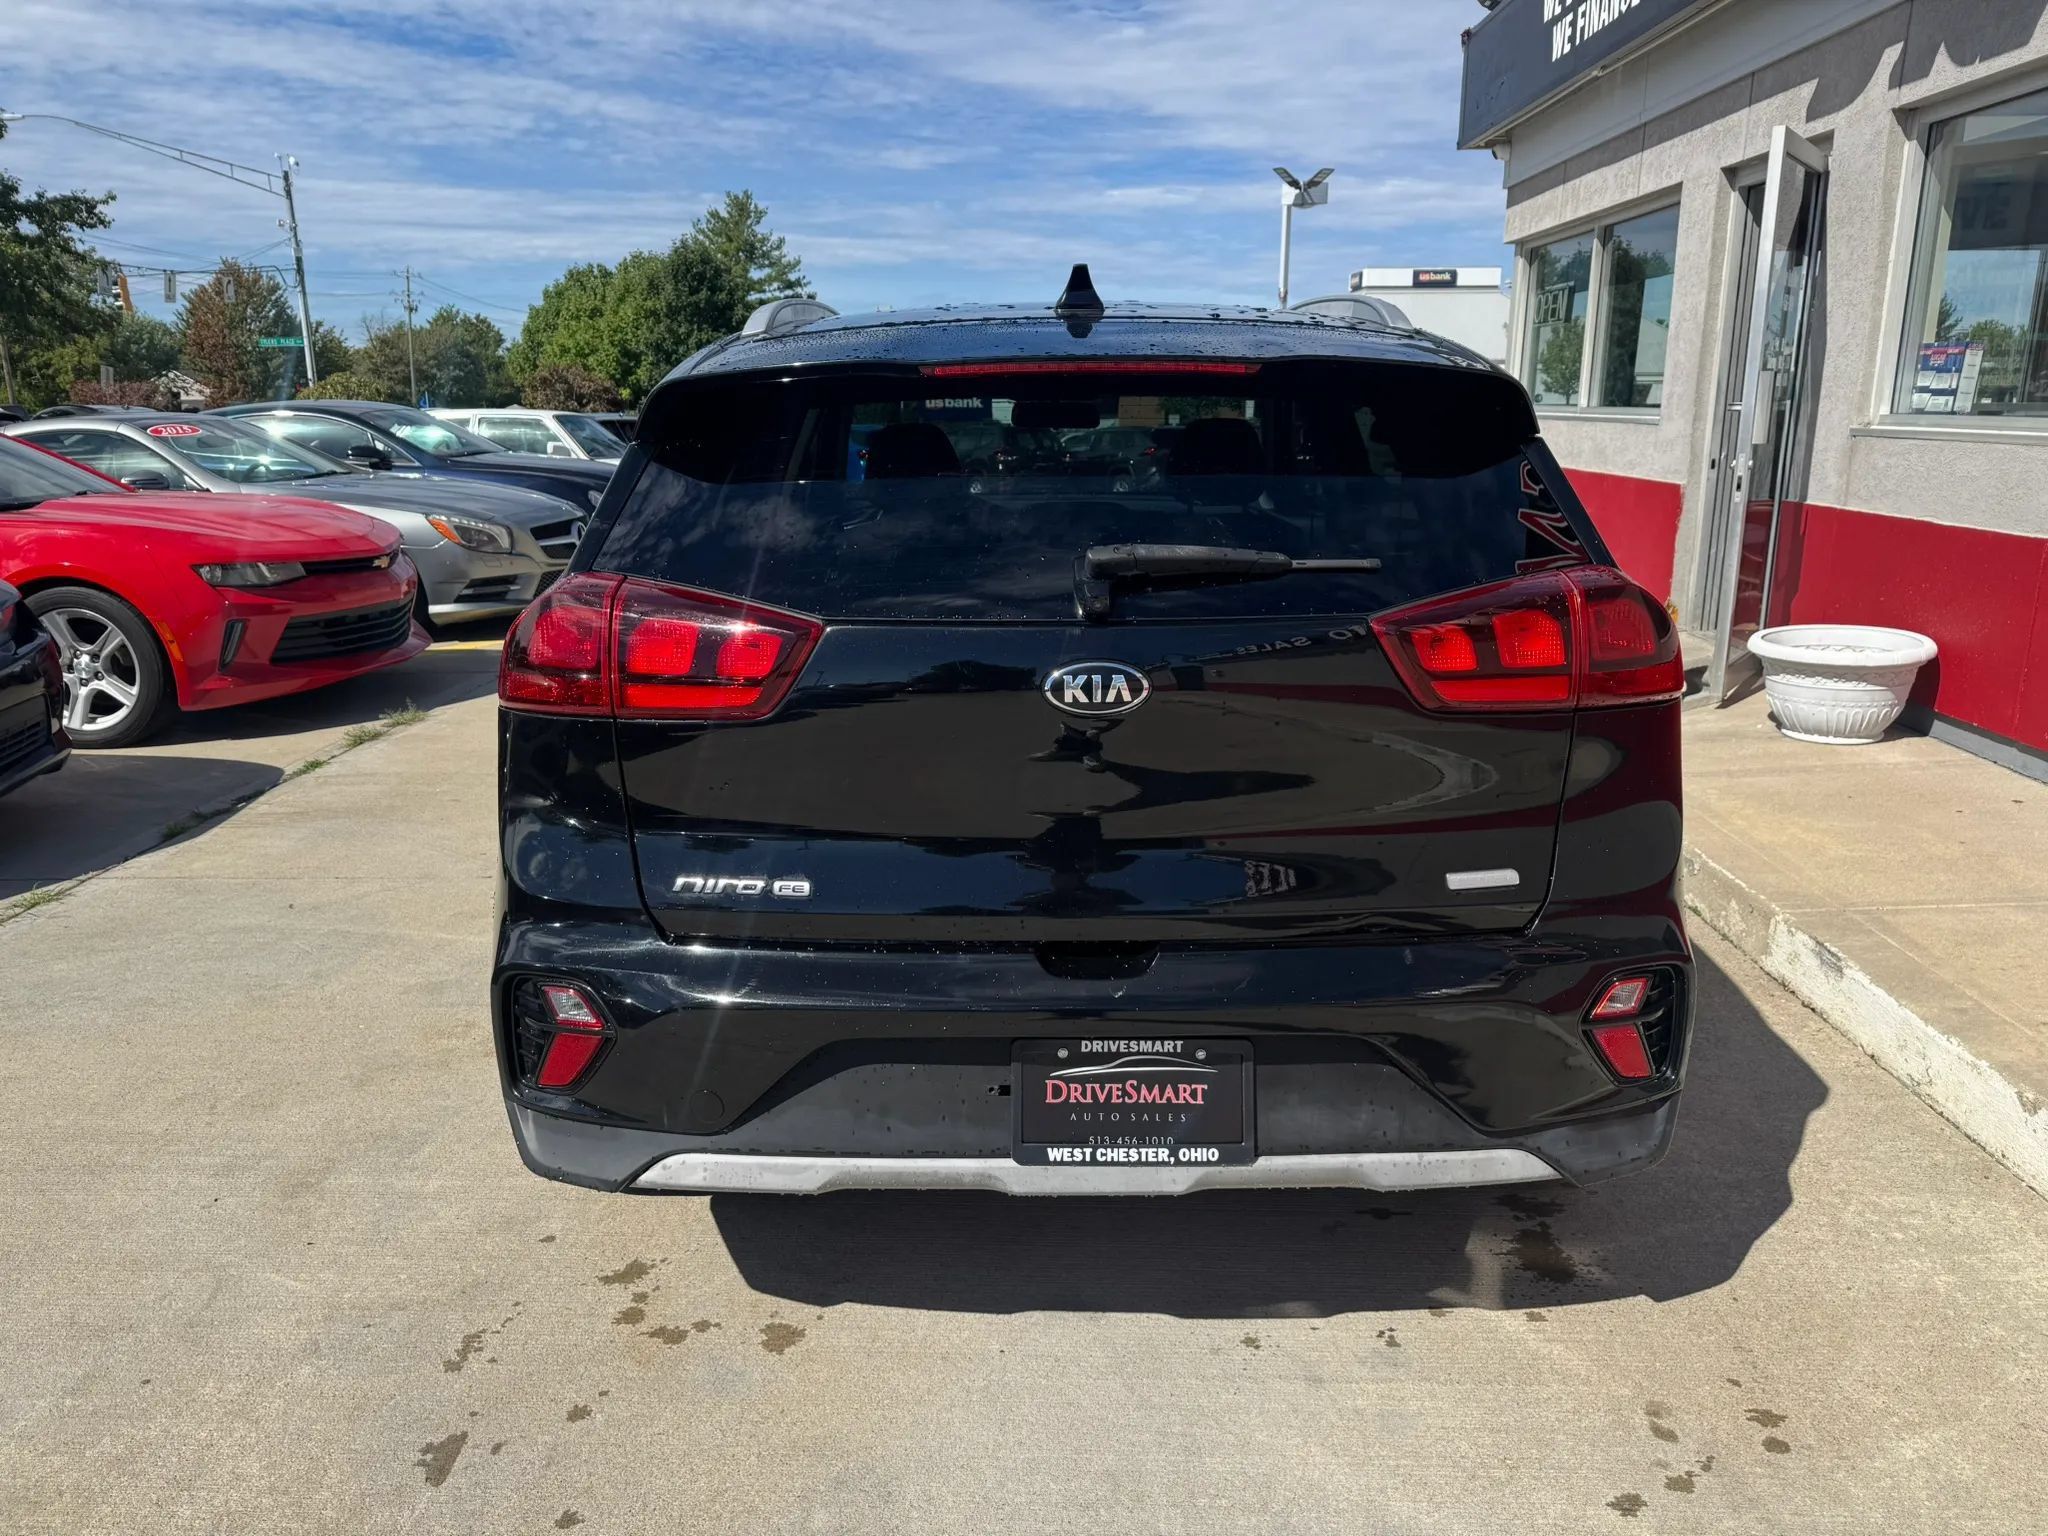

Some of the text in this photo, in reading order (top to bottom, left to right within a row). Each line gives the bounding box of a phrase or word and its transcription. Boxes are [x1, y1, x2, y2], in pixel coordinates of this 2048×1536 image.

[1551, 11, 1574, 62] WE
[1534, 289, 1569, 323] OPEN
[158, 426, 193, 435] 2015
[1062, 674, 1133, 703] KIA
[775, 882, 808, 894] FE
[1081, 1040, 1184, 1053] DRIVESMART
[1070, 1112, 1186, 1122] AUTO SALES
[1088, 1136, 1174, 1145] 513-456-1010
[1046, 1147, 1220, 1165] WEST CHESTER, OHIO
